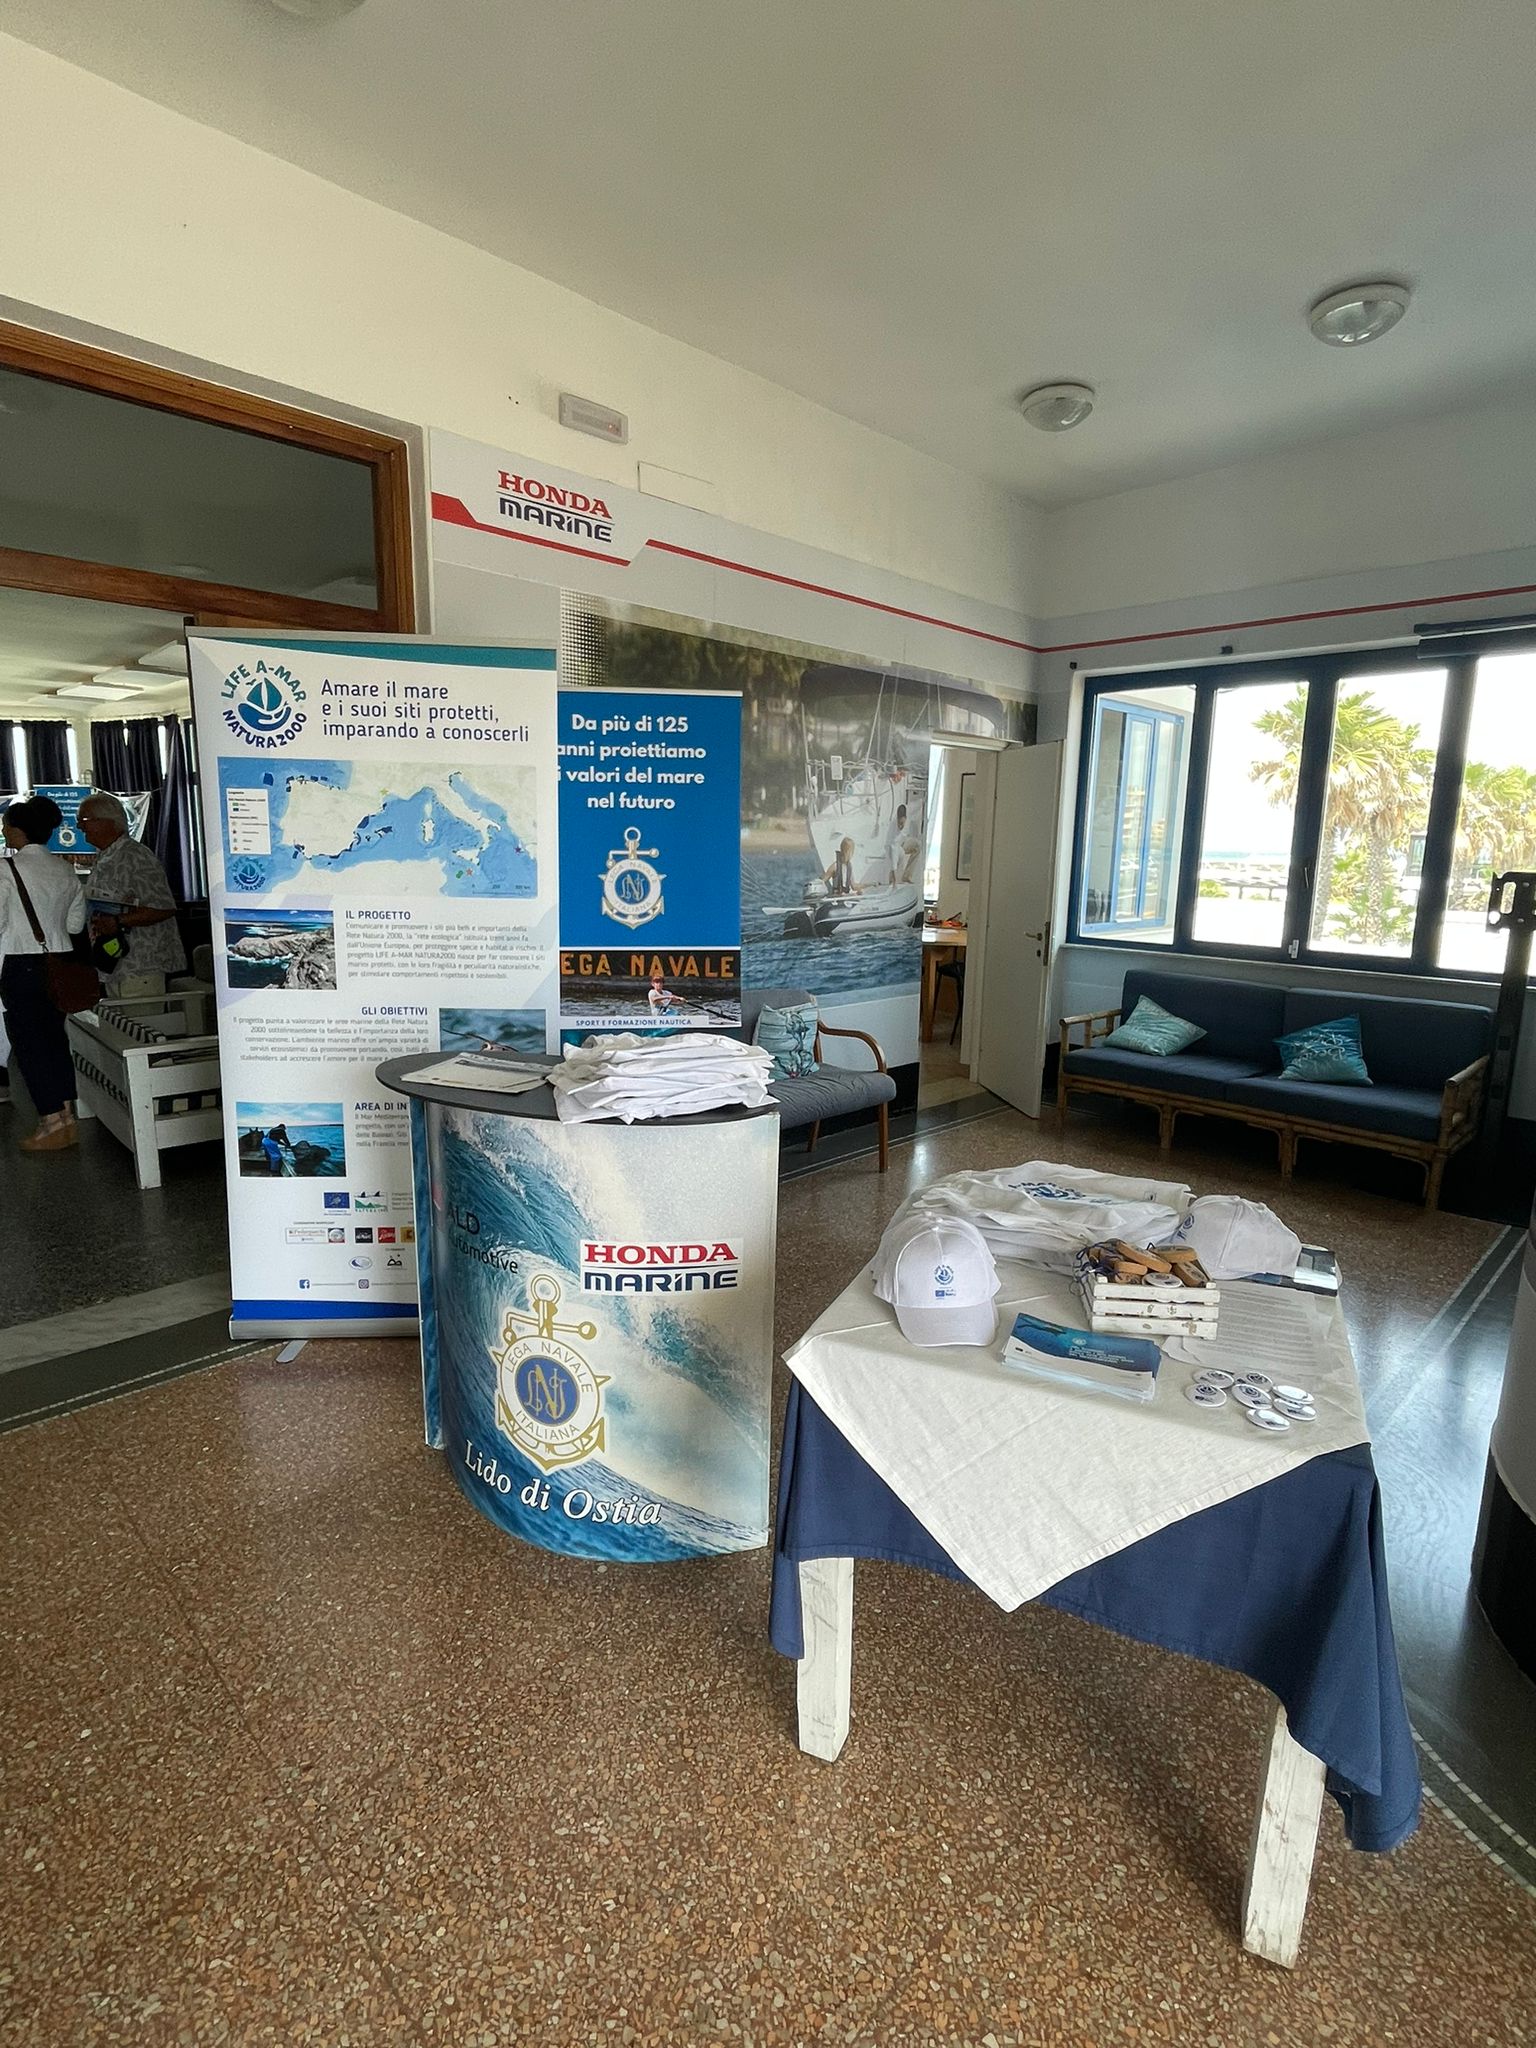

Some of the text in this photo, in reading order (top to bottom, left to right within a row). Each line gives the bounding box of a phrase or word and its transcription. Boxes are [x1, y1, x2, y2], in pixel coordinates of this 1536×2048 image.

[498, 470, 613, 519] HONDA
[221, 660, 306, 702] LIFE A-MAR
[321, 679, 448, 699] Amare il mare
[322, 702, 499, 724] e i suoi siti protetti,
[222, 709, 307, 748] NATURA2000
[323, 721, 529, 742] imparando a conoscerli
[572, 714, 688, 735] Da più di 125
[558, 740, 706, 761] anni proiettiamo
[566, 766, 620, 783] valori
[625, 767, 652, 783] del
[657, 772, 705, 784] mare
[587, 792, 675, 809] nel futuro
[346, 911, 411, 920] IL PROGETTO
[560, 953, 734, 978] EGA NAVALE
[362, 1007, 428, 1015] GLI OBIETTIVI
[576, 1019, 600, 1027] SPORT
[608, 1018, 657, 1026] FORMAZIONE
[585, 1243, 738, 1264] HONDA
[585, 1270, 738, 1292] MARINE
[505, 1342, 593, 1393] LEGA NAVALE
[515, 1410, 580, 1440] ITALIANA
[465, 1440, 662, 1525] Lido di Ostia
